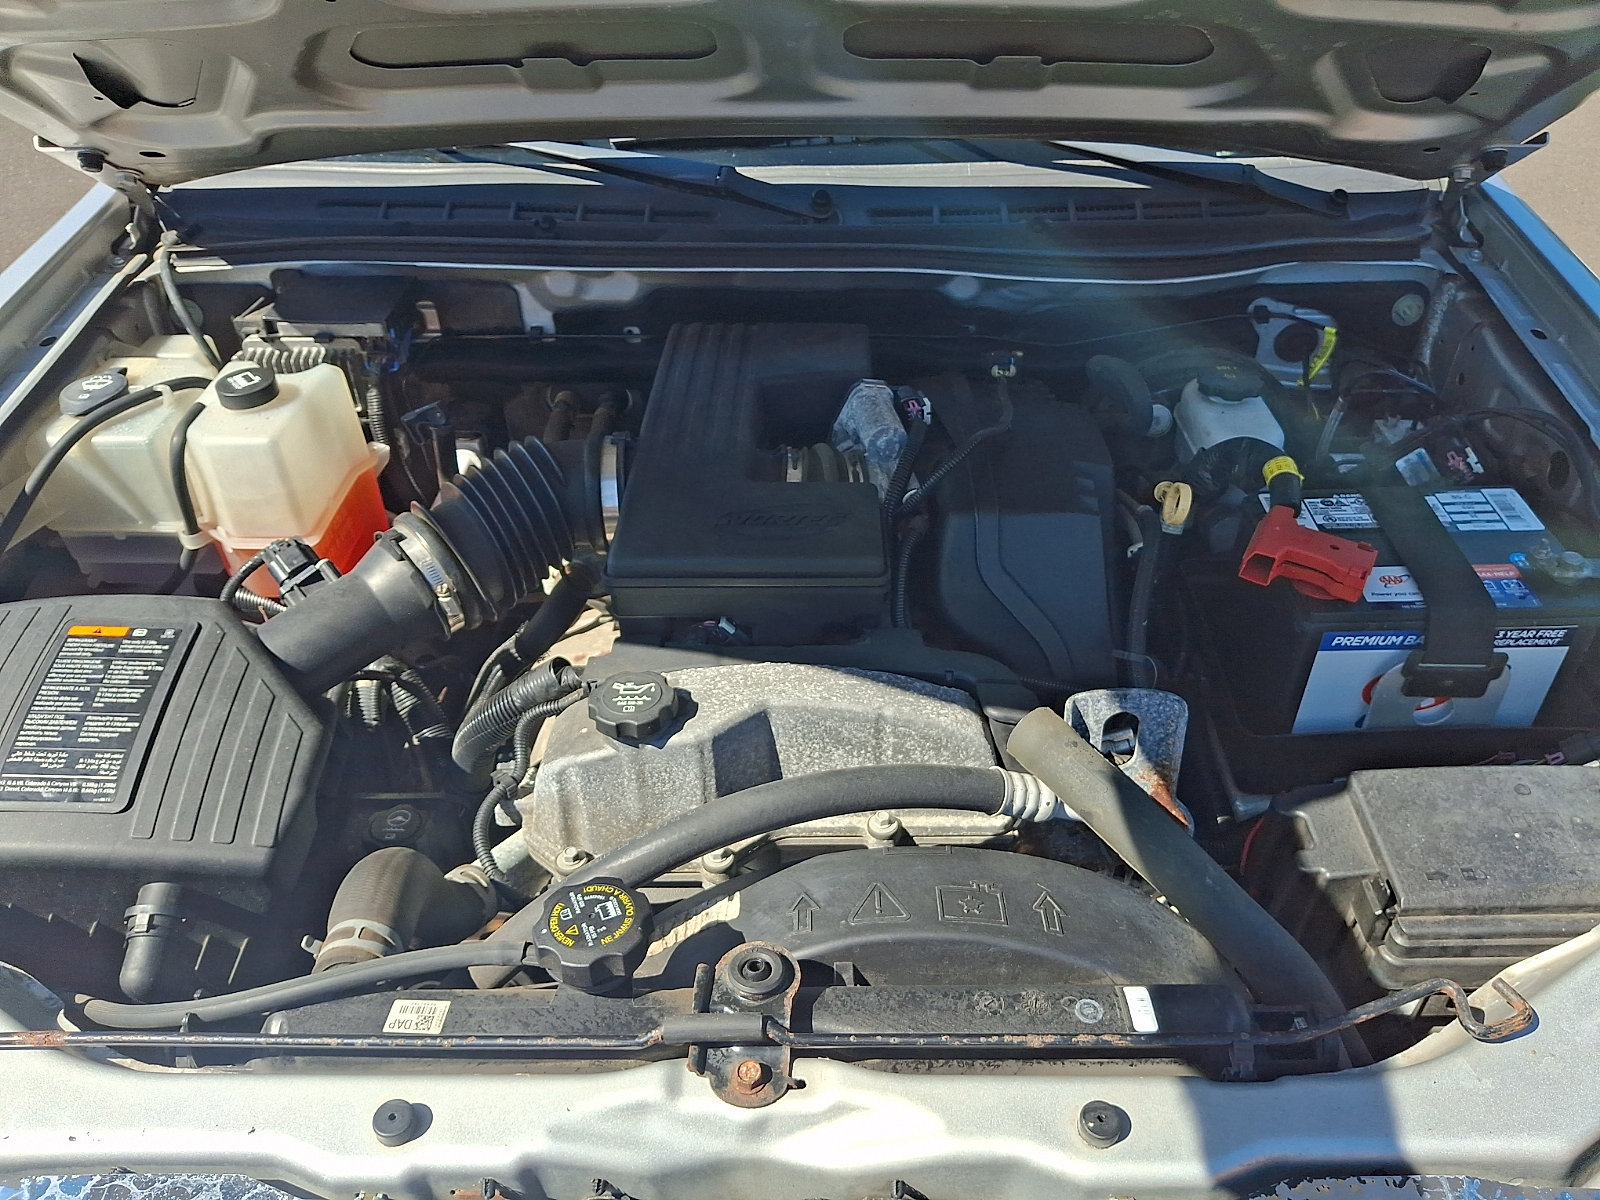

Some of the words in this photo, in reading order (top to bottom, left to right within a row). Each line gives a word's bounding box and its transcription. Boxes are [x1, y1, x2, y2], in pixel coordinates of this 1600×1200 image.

[1505, 630, 1537, 639] YEAR
[1535, 629, 1568, 638] FREE
[1331, 635, 1404, 647] PREMIUM
[1493, 638, 1561, 647] REPLACEMENT
[583, 885, 614, 894] CHAUD!
[619, 892, 634, 916] OUVRIR
[550, 902, 565, 919] HOT!
[549, 916, 560, 934] OPEN
[613, 917, 633, 939] JAMAIS
[553, 930, 575, 947] NEVER
[600, 935, 614, 946] NE
[388, 1018, 413, 1030] DAP
